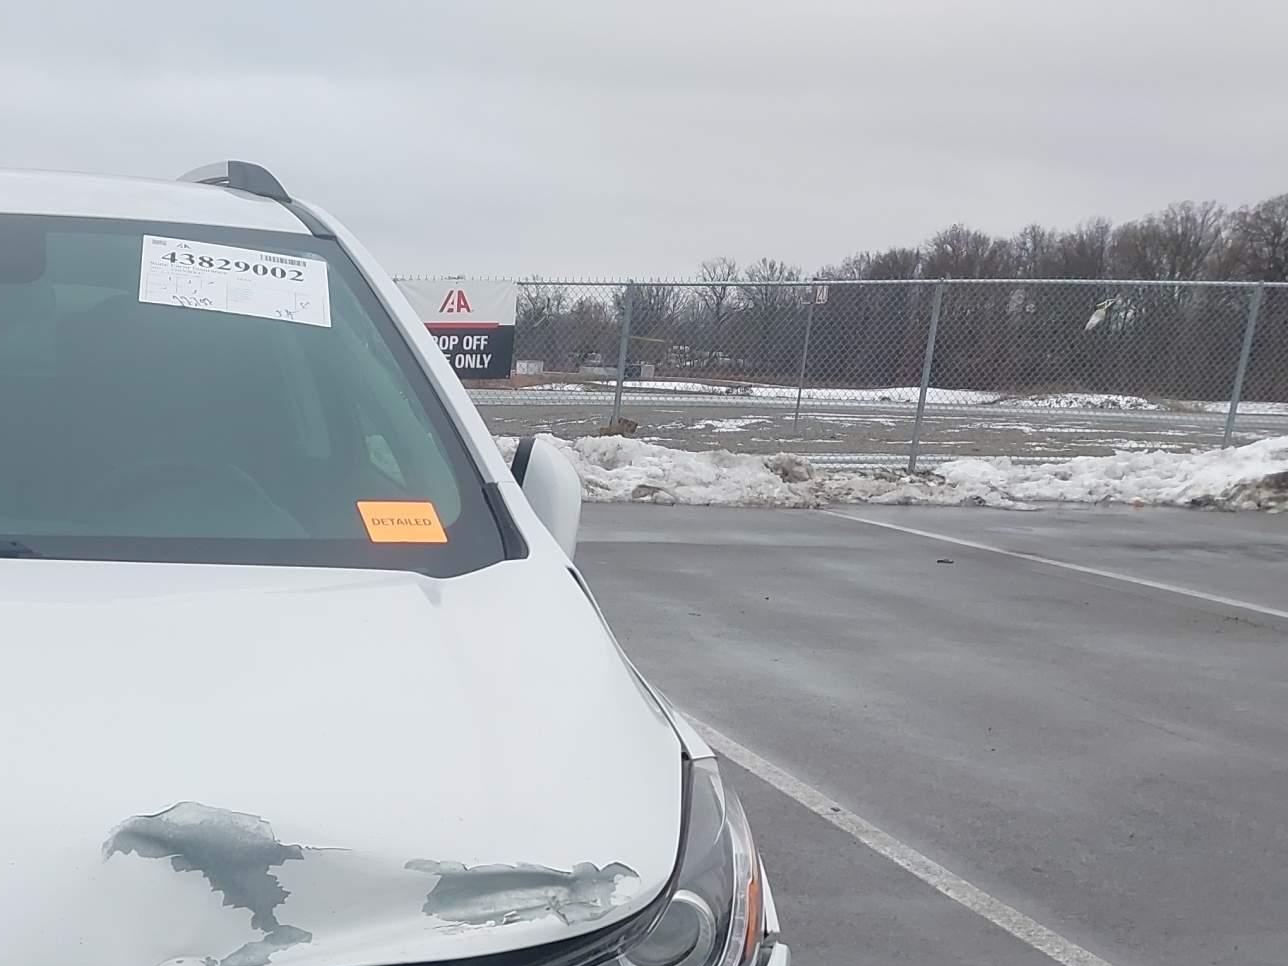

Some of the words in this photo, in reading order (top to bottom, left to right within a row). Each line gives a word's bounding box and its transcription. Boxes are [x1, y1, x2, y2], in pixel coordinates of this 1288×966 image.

[161, 251, 305, 282] 43829002
[463, 335, 489, 351] OFF
[455, 353, 492, 369] ONLY
[371, 518, 432, 526] DETAILED
